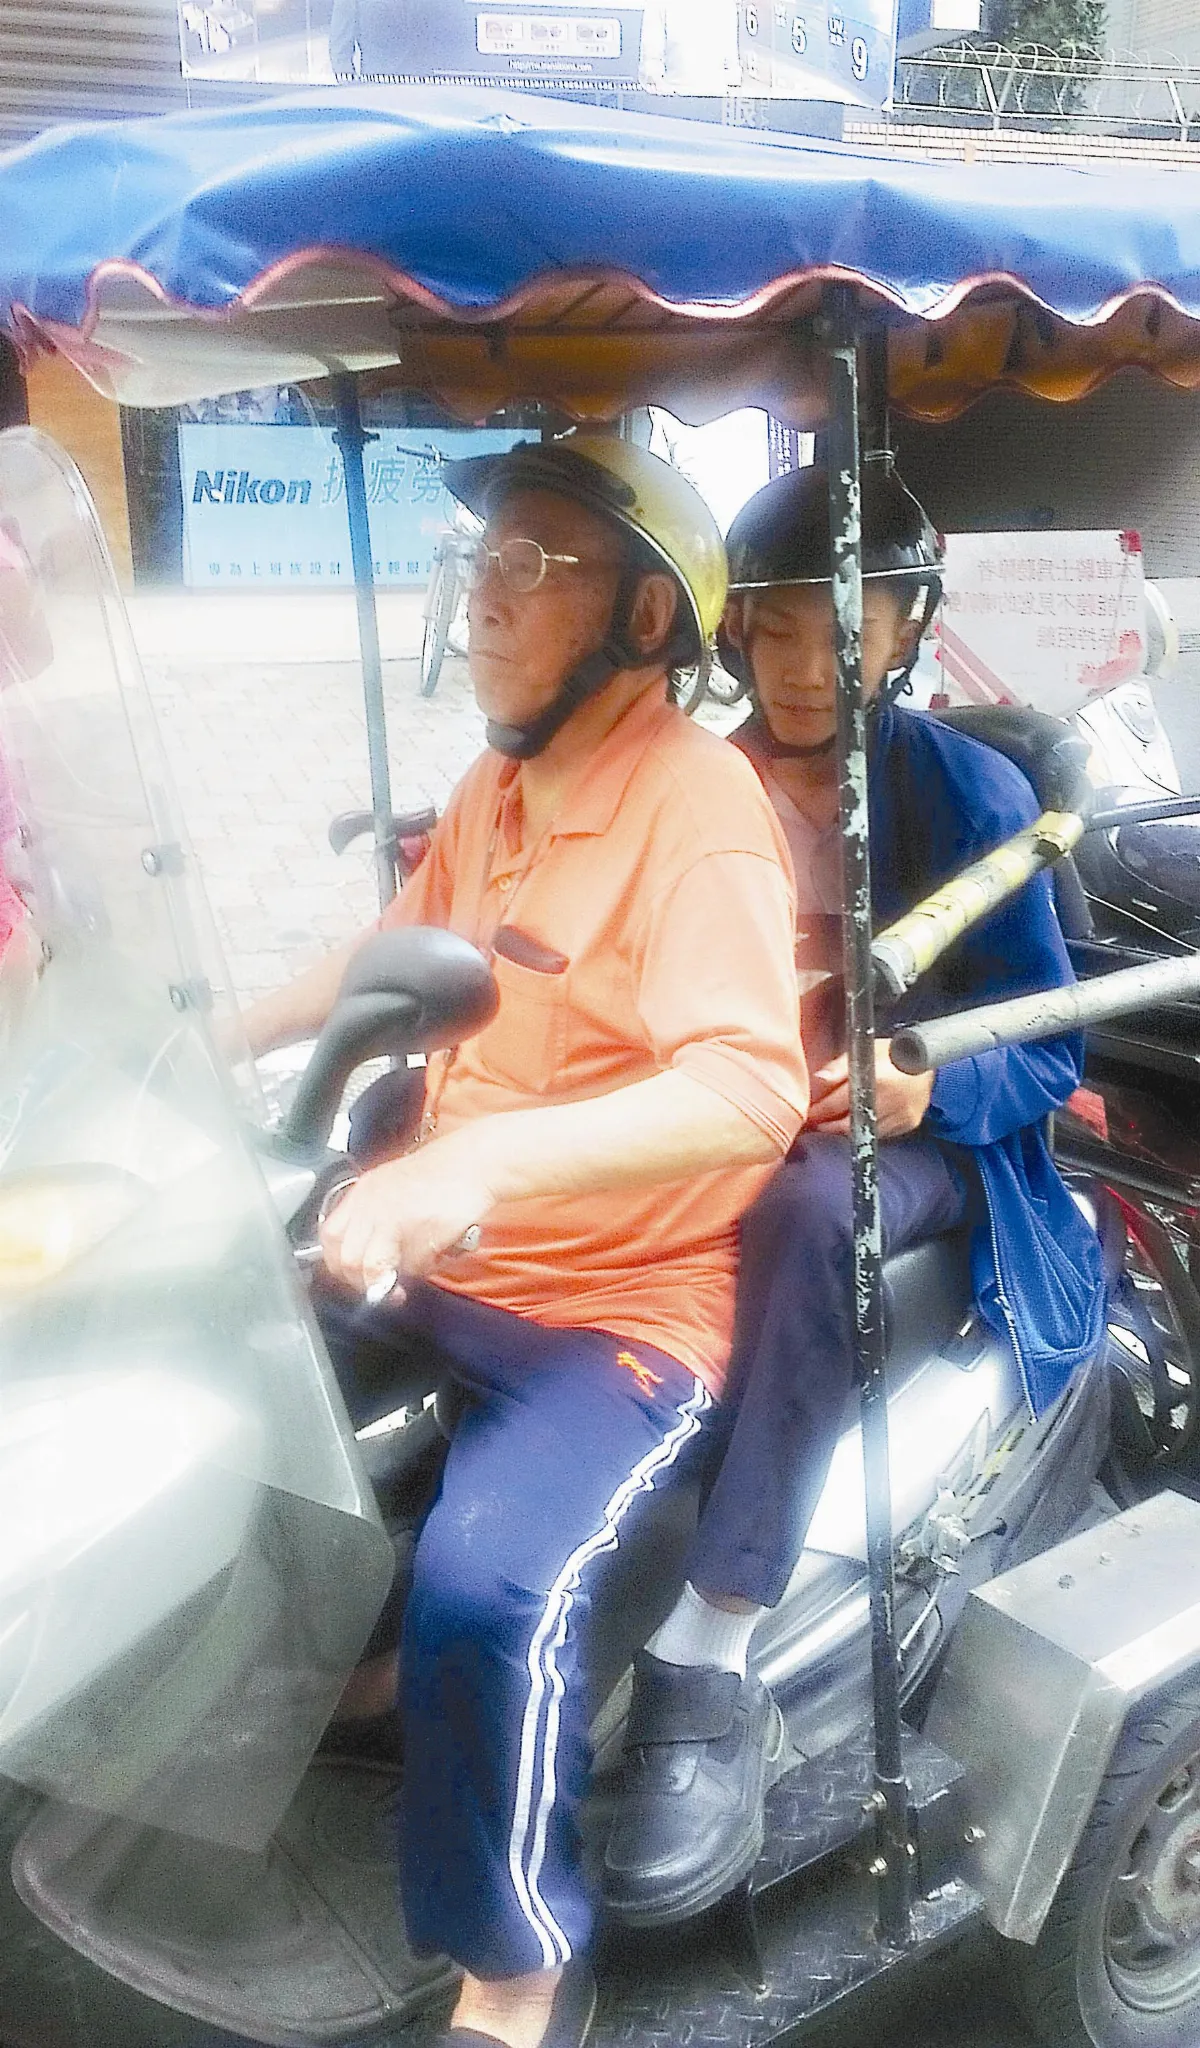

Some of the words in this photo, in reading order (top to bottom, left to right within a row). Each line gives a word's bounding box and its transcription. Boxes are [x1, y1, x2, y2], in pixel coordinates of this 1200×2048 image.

[791, 16, 808, 54] 5
[851, 36, 869, 82] 9
[191, 469, 312, 505] Nikon
